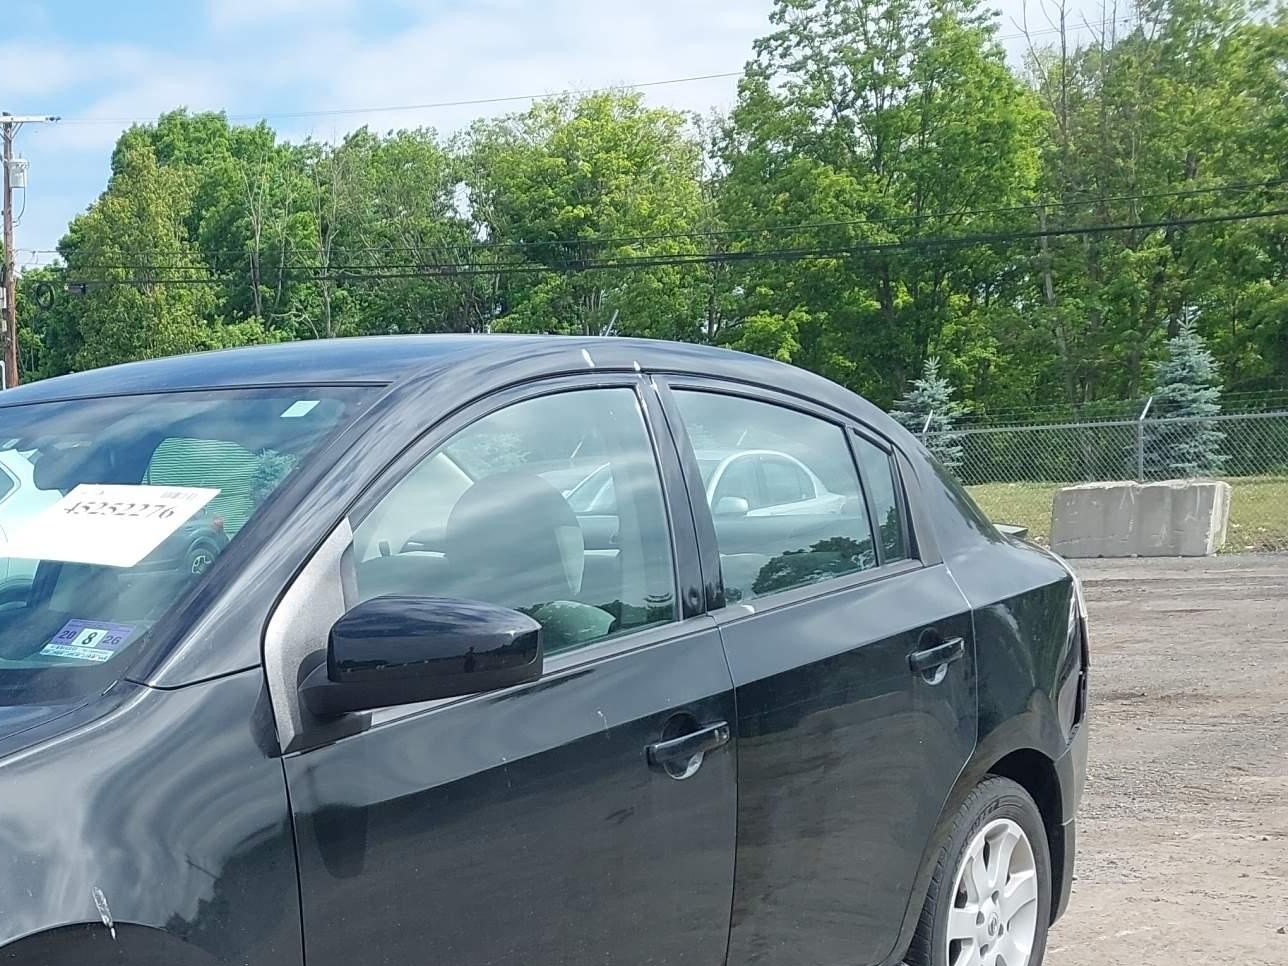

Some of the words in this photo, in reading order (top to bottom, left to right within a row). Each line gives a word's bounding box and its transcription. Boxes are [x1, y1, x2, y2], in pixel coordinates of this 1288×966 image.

[63, 500, 176, 519] 45252276
[58, 630, 78, 641] 20
[81, 631, 98, 646] 8
[102, 635, 123, 646] 26
